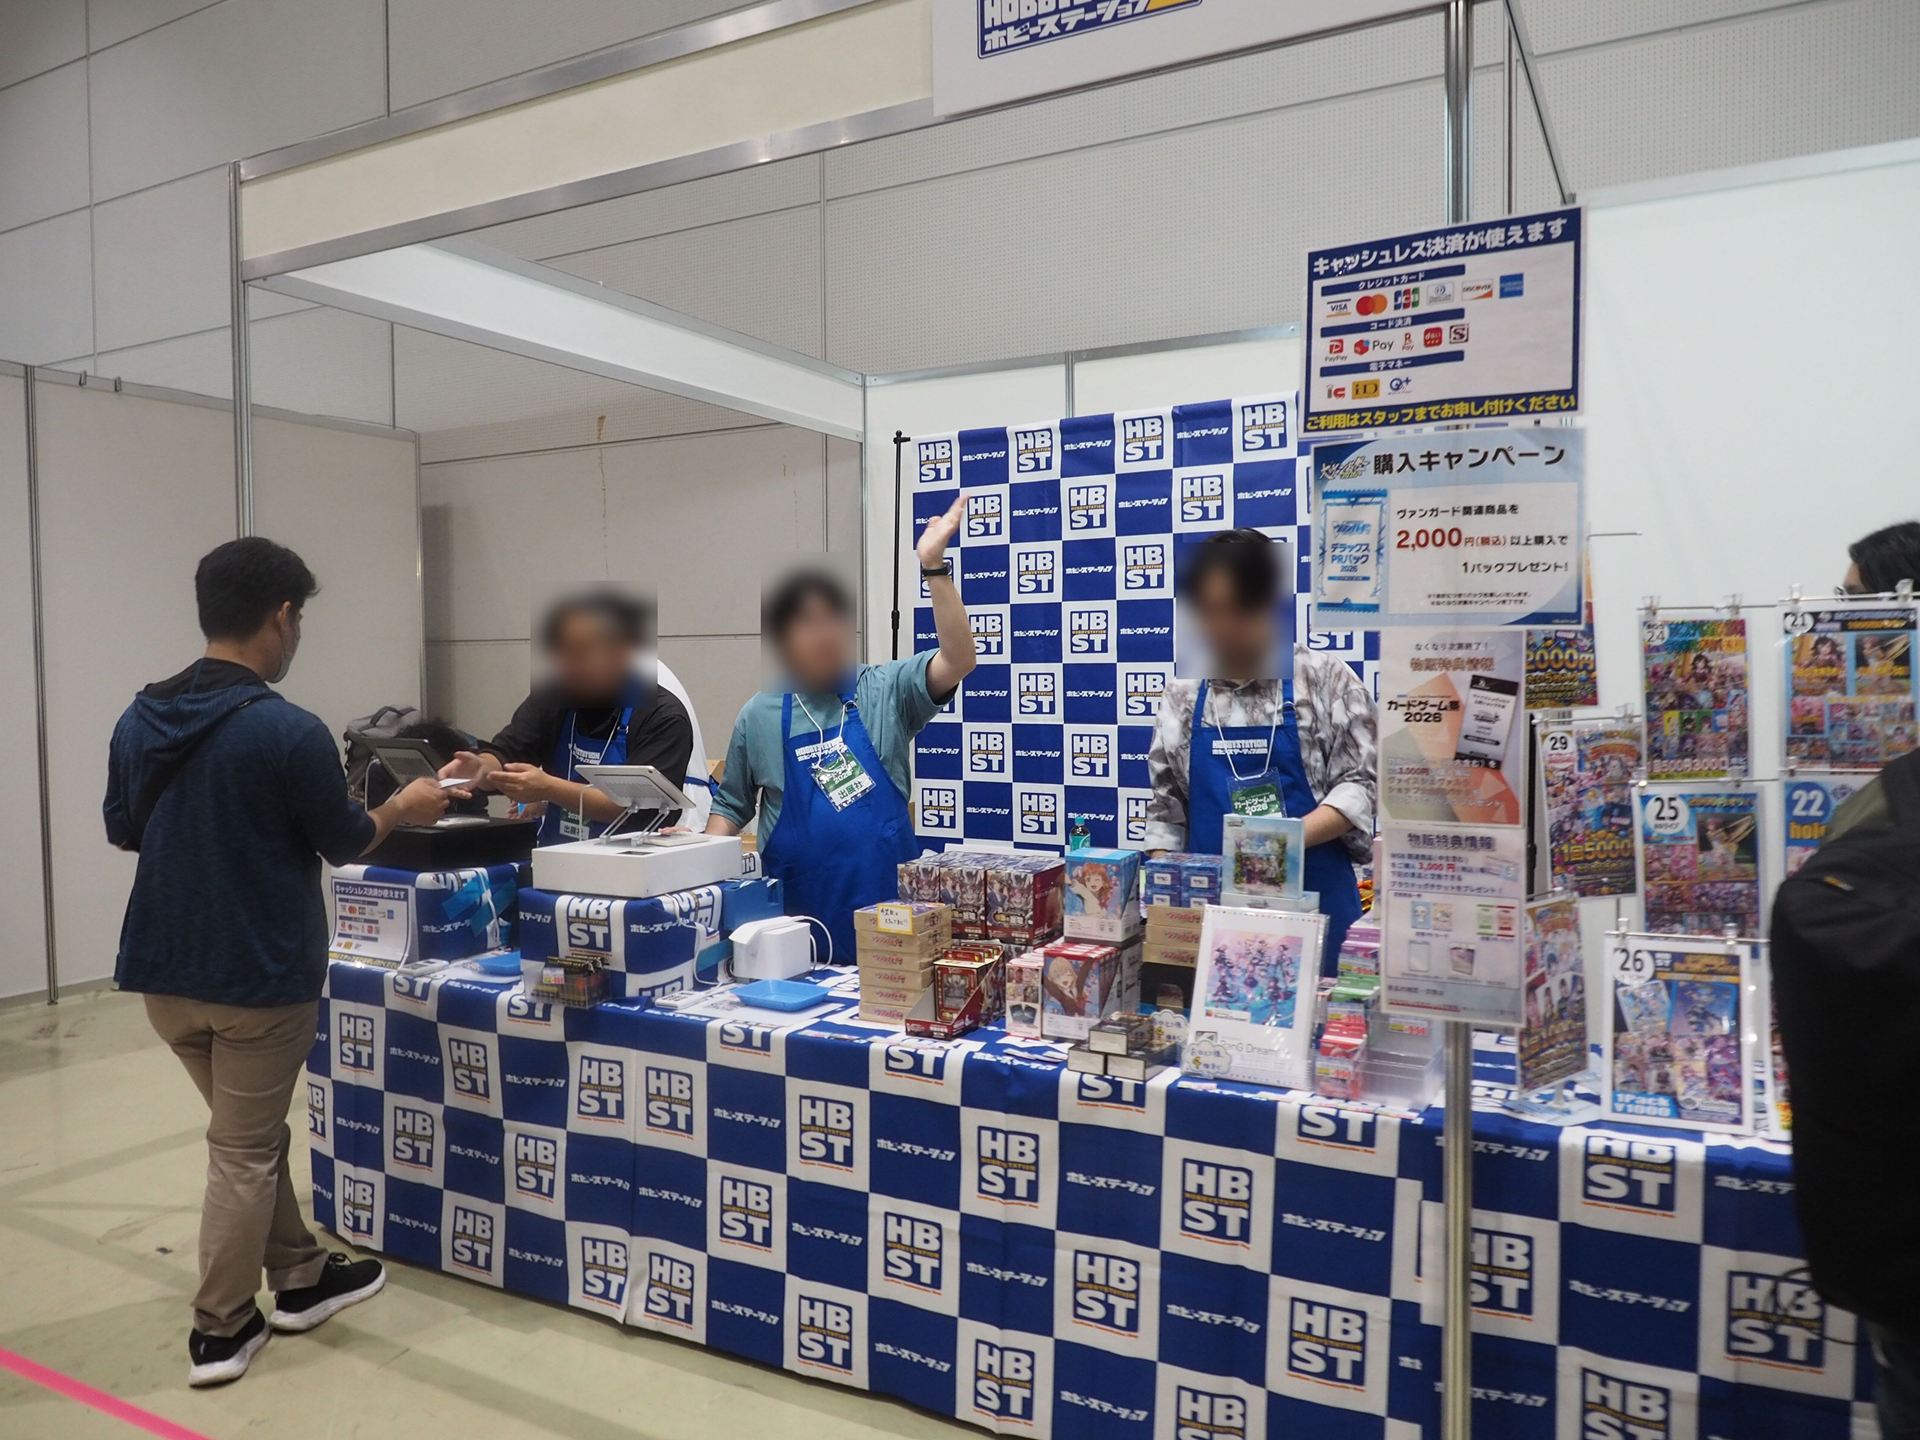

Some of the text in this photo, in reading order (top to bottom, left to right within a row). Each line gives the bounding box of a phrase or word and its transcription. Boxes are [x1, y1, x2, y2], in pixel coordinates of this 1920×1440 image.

[984, 0, 1149, 51] ホビーステーション
[1313, 218, 1567, 276] キャッシュレス決済が使えます
[1358, 273, 1425, 290] クレジットカード
[1330, 303, 1348, 312] VISA
[1394, 289, 1420, 309] JCB
[1369, 317, 1412, 331] コード決済
[1244, 405, 1284, 428] HB
[1306, 394, 1576, 431] ご利用はスタッフまでお申し付けください
[1017, 431, 1051, 451] HB
[1125, 418, 1162, 439] HB
[1244, 423, 1284, 449] ST
[920, 442, 950, 463] HB
[1019, 448, 1051, 470] ST
[1126, 439, 1161, 460] ST
[1373, 445, 1565, 475] 購入キャンペーン
[921, 460, 950, 480] ST
[1071, 487, 1105, 507] HB
[1183, 477, 1221, 497] HB
[969, 497, 1000, 516] HB
[1071, 507, 1104, 527] ST
[1183, 496, 1221, 520] ST
[1396, 503, 1520, 520] ヴァンガード関連商品を
[969, 516, 1000, 535] ST
[1020, 553, 1052, 573] HB
[1127, 547, 1162, 568] HB
[1019, 574, 1052, 592] ST
[1127, 566, 1162, 587] ST
[969, 616, 1001, 633] HB
[1072, 613, 1106, 630] HB
[1791, 614, 1807, 628] 21
[1072, 634, 1106, 651] ST
[1309, 631, 1351, 649] ST
[1021, 675, 1053, 691] HB
[1128, 674, 1163, 692] HB
[1021, 692, 1053, 712] ST
[972, 734, 1003, 750] HB
[1074, 736, 1107, 753] HB
[1550, 736, 1569, 751] 29
[972, 754, 1002, 770] ST
[1074, 757, 1107, 775] ST
[924, 790, 954, 806] HB
[1023, 795, 1055, 812] HB
[1656, 797, 1679, 821] 25
[1792, 789, 1825, 816] 22
[924, 810, 954, 826] ST
[1023, 815, 1055, 832] ST
[569, 897, 611, 919] HB
[570, 923, 608, 948] ST
[1619, 948, 1645, 972] 26
[342, 1016, 372, 1040] HB
[723, 1023, 771, 1047] ST
[342, 1042, 372, 1066] ST
[451, 1042, 485, 1067] HB
[888, 1047, 947, 1075] ST
[455, 1069, 486, 1094] ST
[581, 1059, 621, 1086] HB
[648, 1070, 690, 1099] HB
[1082, 1071, 1144, 1101] ST
[580, 1089, 621, 1115] ST
[801, 1099, 850, 1130] HB
[396, 1110, 432, 1136] HB
[649, 1101, 690, 1129] ST
[1300, 1106, 1374, 1142] ST
[396, 1137, 431, 1162] ST
[517, 1137, 554, 1164] HB
[801, 1131, 850, 1162] ST
[981, 1130, 1036, 1163] HB
[1589, 1136, 1672, 1164] HB
[345, 1178, 372, 1205] HB
[518, 1166, 553, 1193] ST
[981, 1165, 1035, 1197] ST
[1067, 1172, 1155, 1195] ホビーステーション
[1185, 1163, 1249, 1200] HB
[1588, 1164, 1670, 1204] ST
[723, 1180, 769, 1212] HB
[344, 1205, 371, 1231] ST
[456, 1210, 491, 1239] HB
[723, 1212, 769, 1242] ST
[1184, 1201, 1248, 1236] ST
[1283, 1214, 1385, 1241] ホビーステーション
[887, 1216, 940, 1251] HB
[454, 1239, 490, 1267] ST
[585, 1240, 626, 1268] HB
[652, 1256, 691, 1289] HB
[887, 1249, 939, 1284] ST
[1077, 1254, 1136, 1291] HB
[586, 1269, 625, 1299] ST
[1570, 1280, 1690, 1312] ホビーステーション
[648, 1287, 690, 1319] ST
[1077, 1290, 1135, 1327] ST
[801, 1299, 849, 1333] HB
[1293, 1302, 1363, 1342] HB
[800, 1332, 849, 1364] ST
[1731, 1319, 1818, 1360] ST
[978, 1344, 1031, 1380] HB
[1292, 1341, 1362, 1379] ST
[977, 1380, 1030, 1414] ST
[1180, 1390, 1244, 1427] HB
[1584, 1373, 1666, 1422] HB
